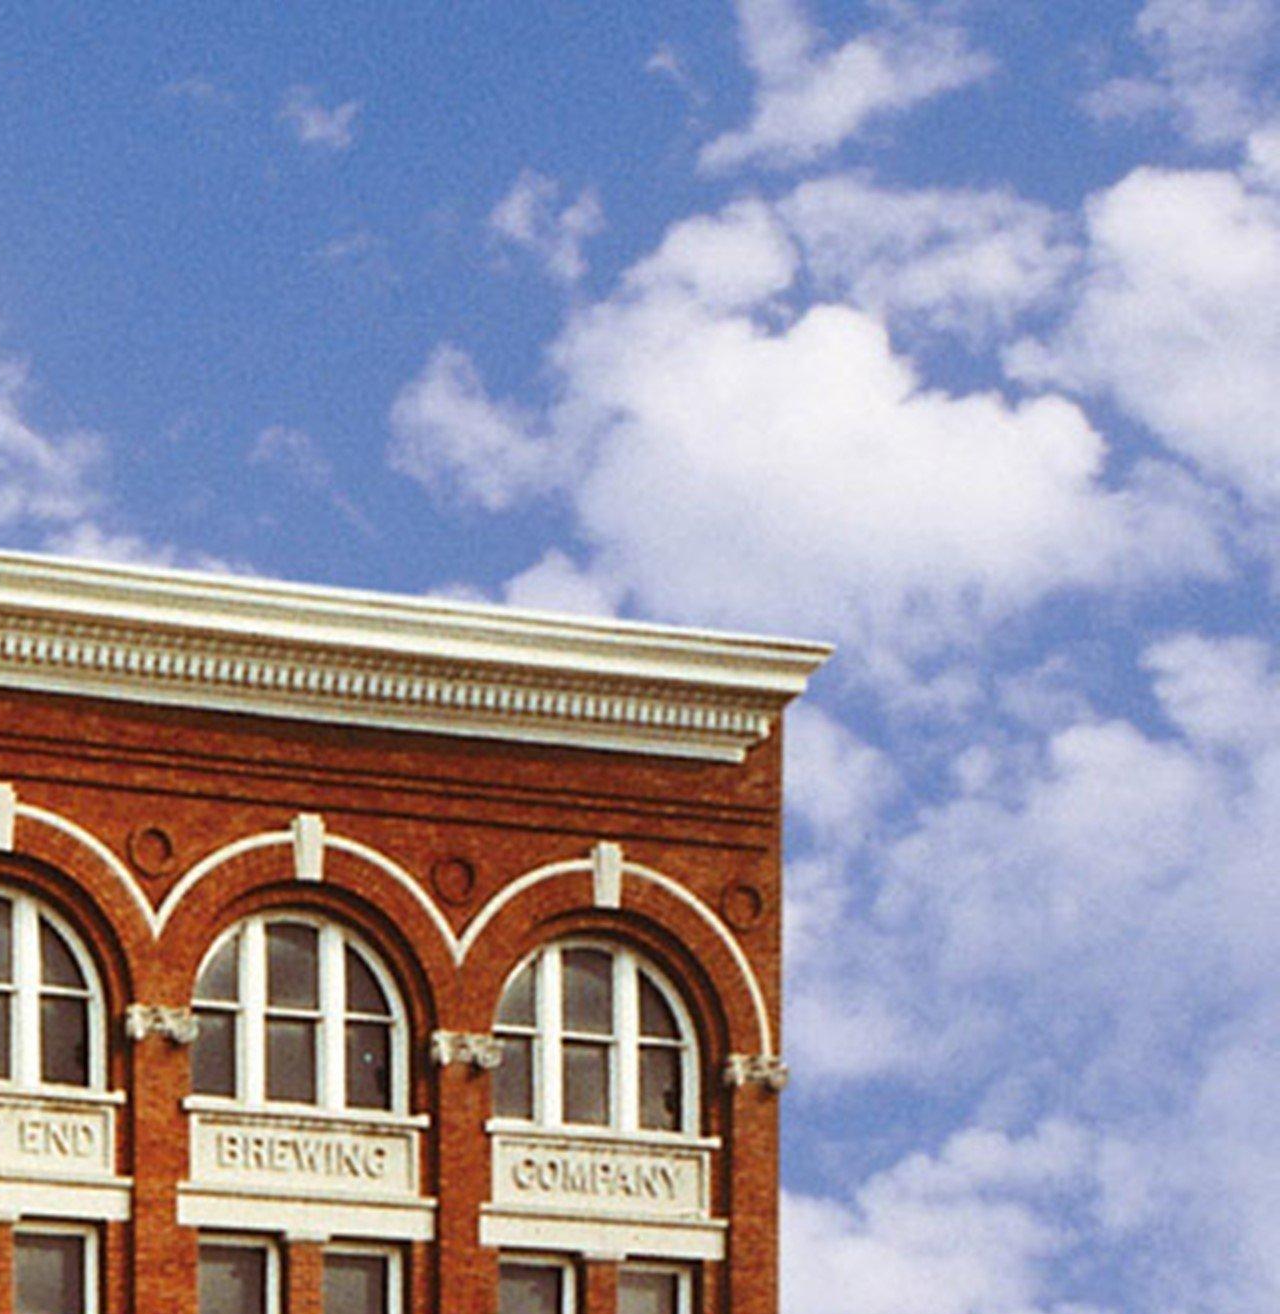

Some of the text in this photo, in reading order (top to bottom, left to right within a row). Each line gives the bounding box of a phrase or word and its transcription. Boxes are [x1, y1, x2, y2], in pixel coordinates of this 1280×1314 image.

[17, 1118, 96, 1159] END
[216, 1131, 387, 1180] BREWING
[513, 1157, 683, 1202] COMPANY
